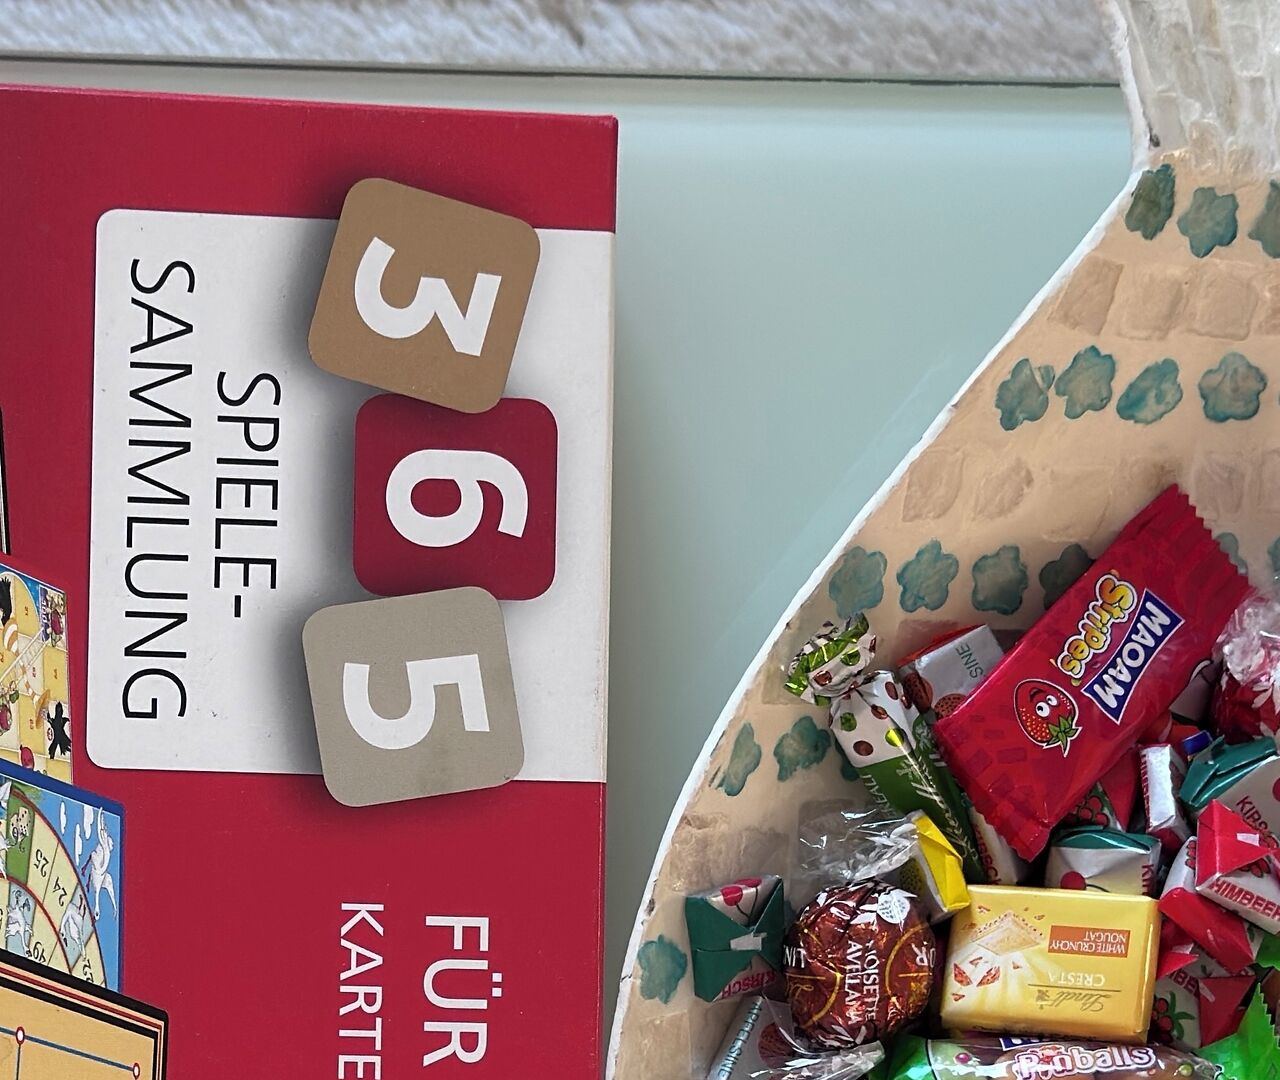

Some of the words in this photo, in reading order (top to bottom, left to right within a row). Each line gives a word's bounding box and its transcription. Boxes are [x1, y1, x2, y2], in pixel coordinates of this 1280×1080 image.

[122, 258, 195, 719] SAMMLUNG
[213, 371, 282, 618] SPIELE-
[1093, 601, 1172, 709] MAOAM
[35, 849, 49, 878] 25
[1050, 939, 1096, 952] CRUNCHY
[1085, 930, 1127, 942] NOUGAT
[1096, 943, 1126, 954] WHITE
[422, 915, 502, 1068] FÜR
[844, 940, 860, 1024] AVELLANA
[1047, 971, 1105, 985] CRESTA
